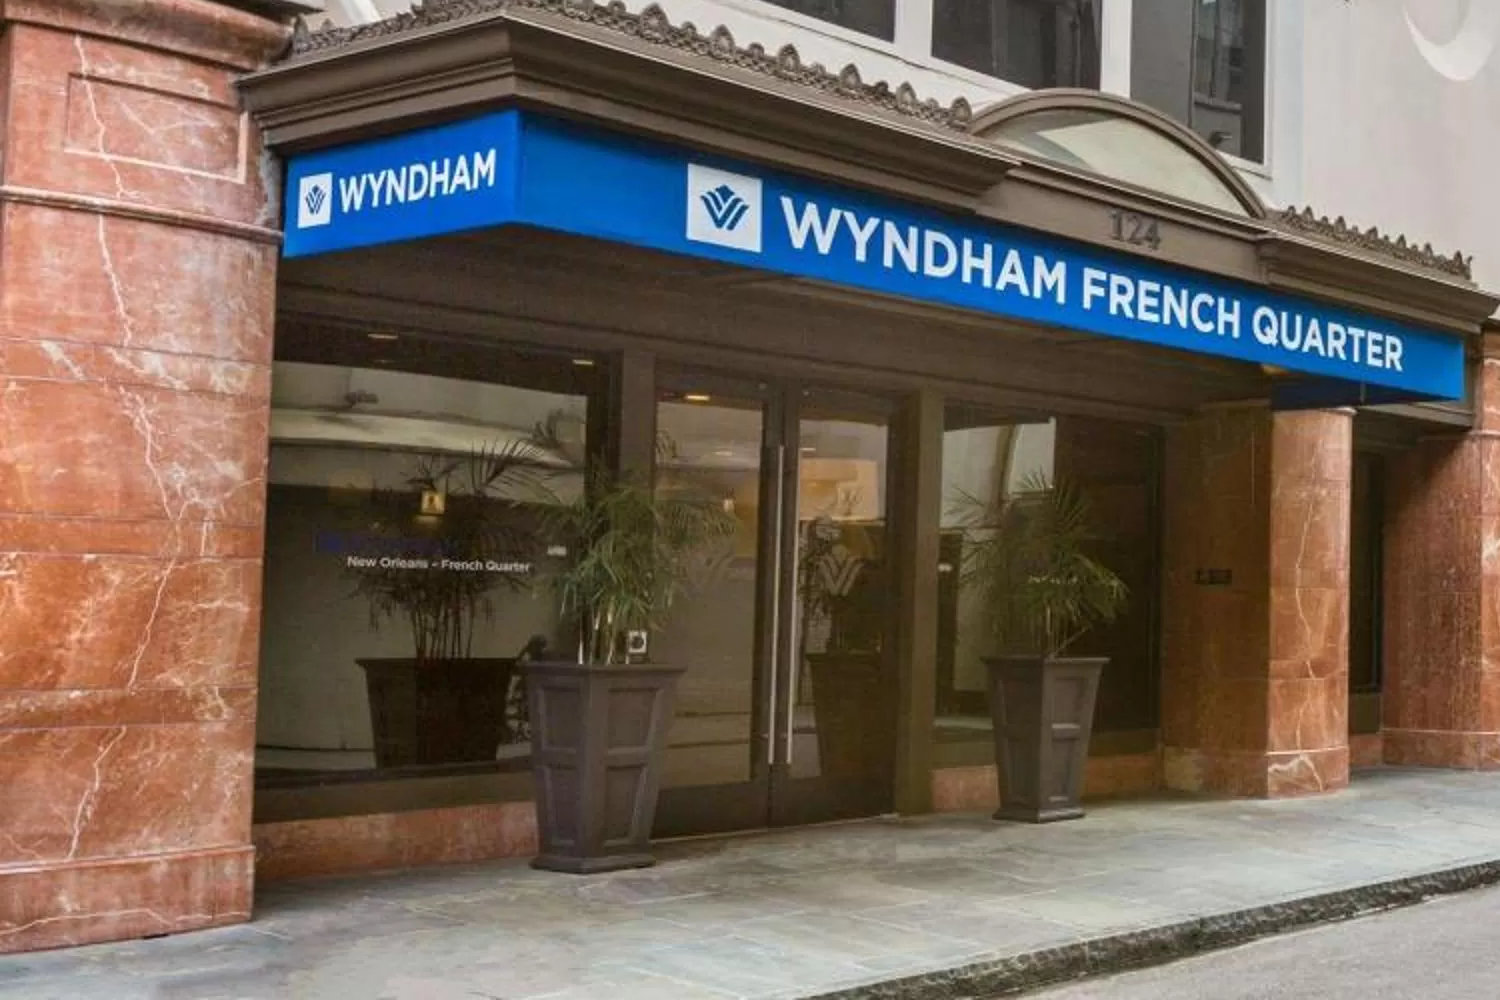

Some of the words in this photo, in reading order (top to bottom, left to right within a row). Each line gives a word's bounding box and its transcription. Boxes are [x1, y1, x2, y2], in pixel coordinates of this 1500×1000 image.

[339, 148, 495, 213] WYNDHAM
[1110, 208, 1161, 249] 124
[780, 195, 1066, 305] WYNDHAM
[1082, 265, 1241, 339] FRENCH
[1252, 304, 1404, 372] QUARTER
[347, 555, 376, 568] New
[380, 556, 428, 569] Orleans
[441, 558, 483, 571] French
[485, 560, 530, 573] Quarter
